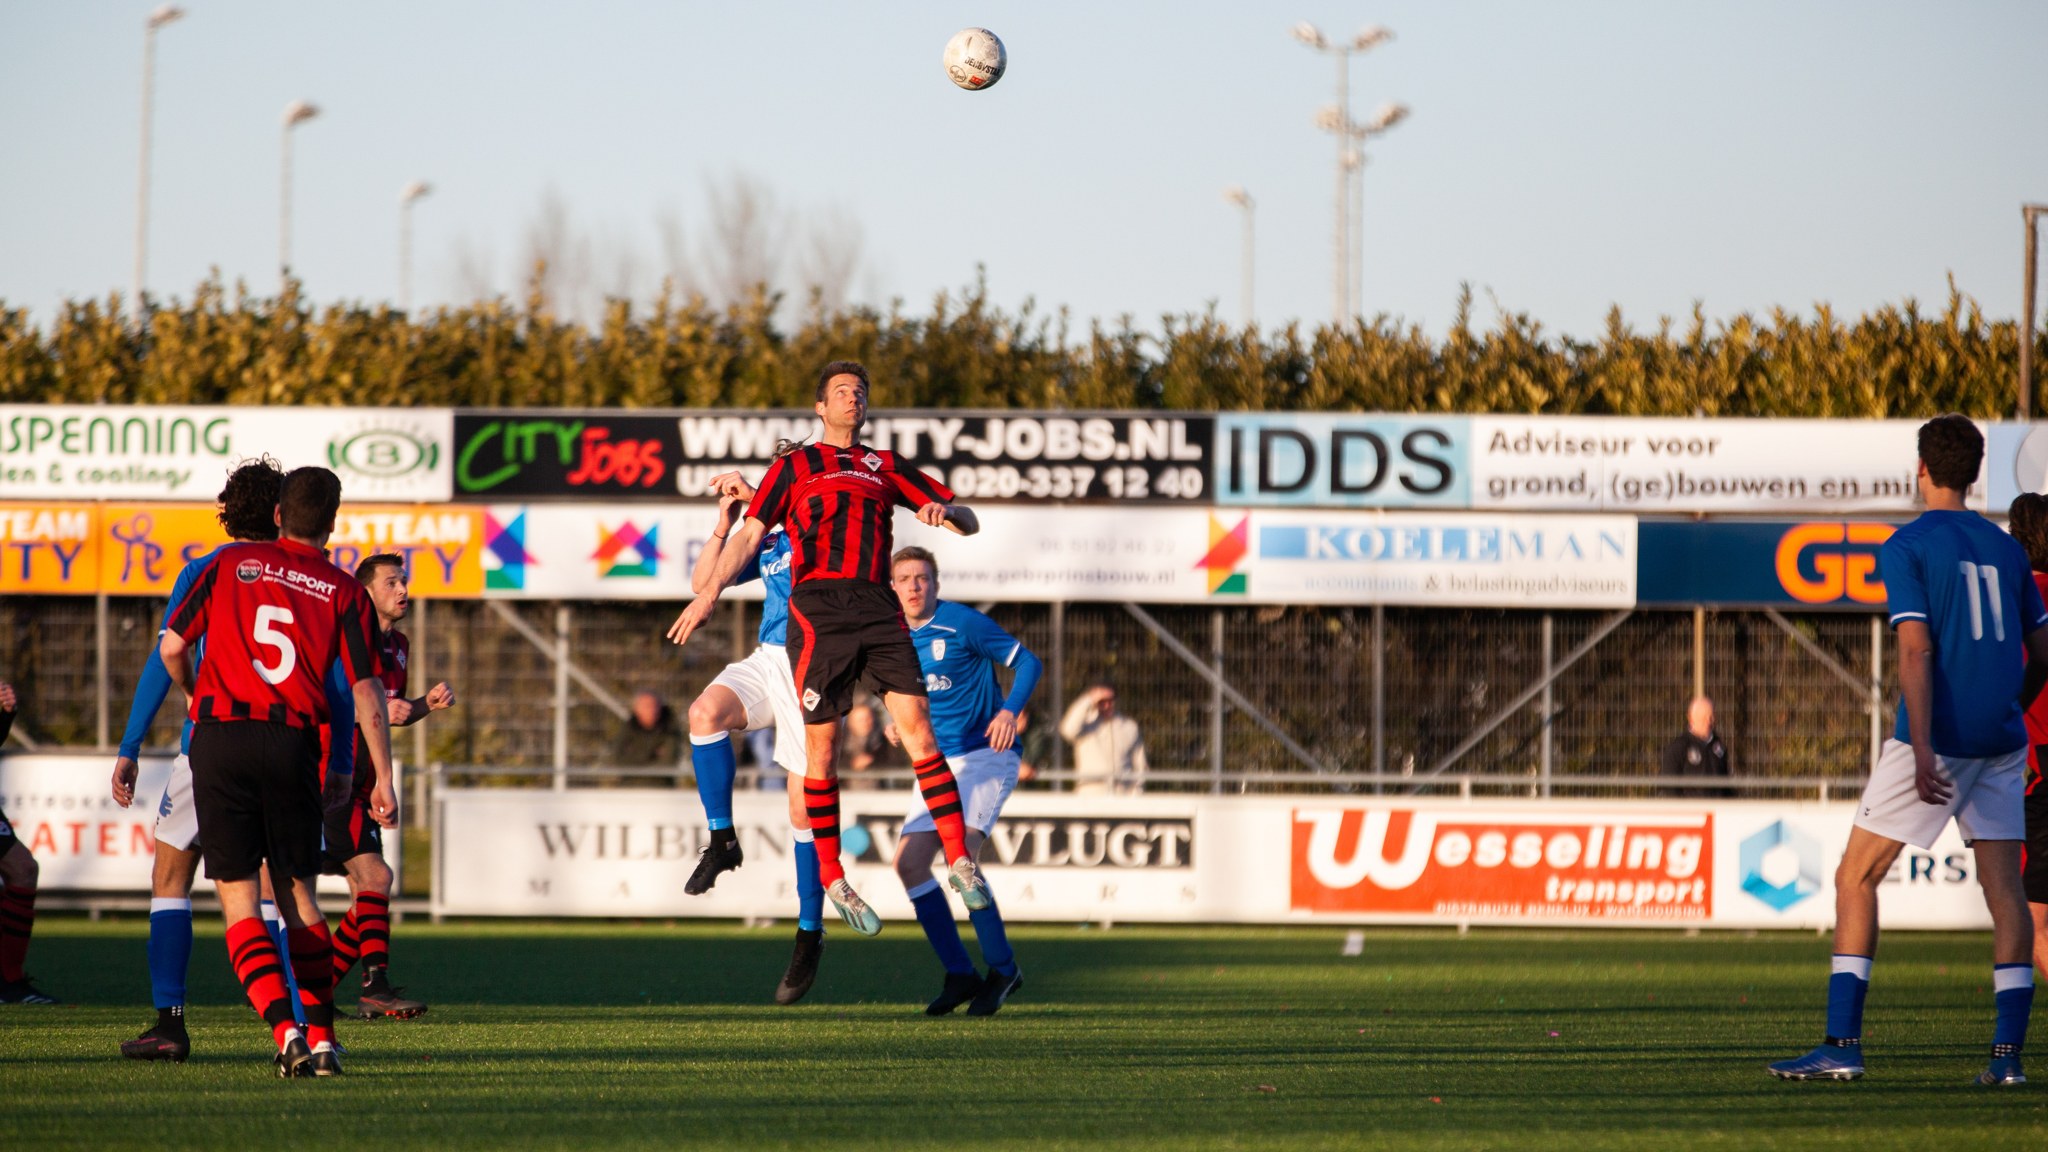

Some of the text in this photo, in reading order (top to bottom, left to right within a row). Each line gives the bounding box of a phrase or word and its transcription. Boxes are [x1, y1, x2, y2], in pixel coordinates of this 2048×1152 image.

[0, 416, 230, 455] SPENNING
[679, 417, 1203, 460] WWWITY-JOBS.NL
[1488, 430, 1721, 457] Adviseur voor
[77, 465, 192, 489] coatings
[1229, 427, 1455, 496] IDDS
[951, 466, 1096, 497] 020-337
[1104, 467, 1149, 497] 12
[1156, 468, 1203, 498] 40
[1488, 472, 1598, 499] grond,
[1611, 472, 1806, 500] (ge)bouwen
[1820, 477, 1859, 497] en
[0, 542, 83, 581] TY
[1305, 526, 1627, 562] KOELEMAN
[286, 569, 337, 596] SPORT
[1425, 572, 1441, 593] &
[1449, 570, 1629, 597] belastingadviseurs
[1959, 560, 2006, 642] 11
[252, 604, 297, 685] 5
[1296, 810, 1704, 890] Wesseling
[1545, 875, 1707, 906] transport
